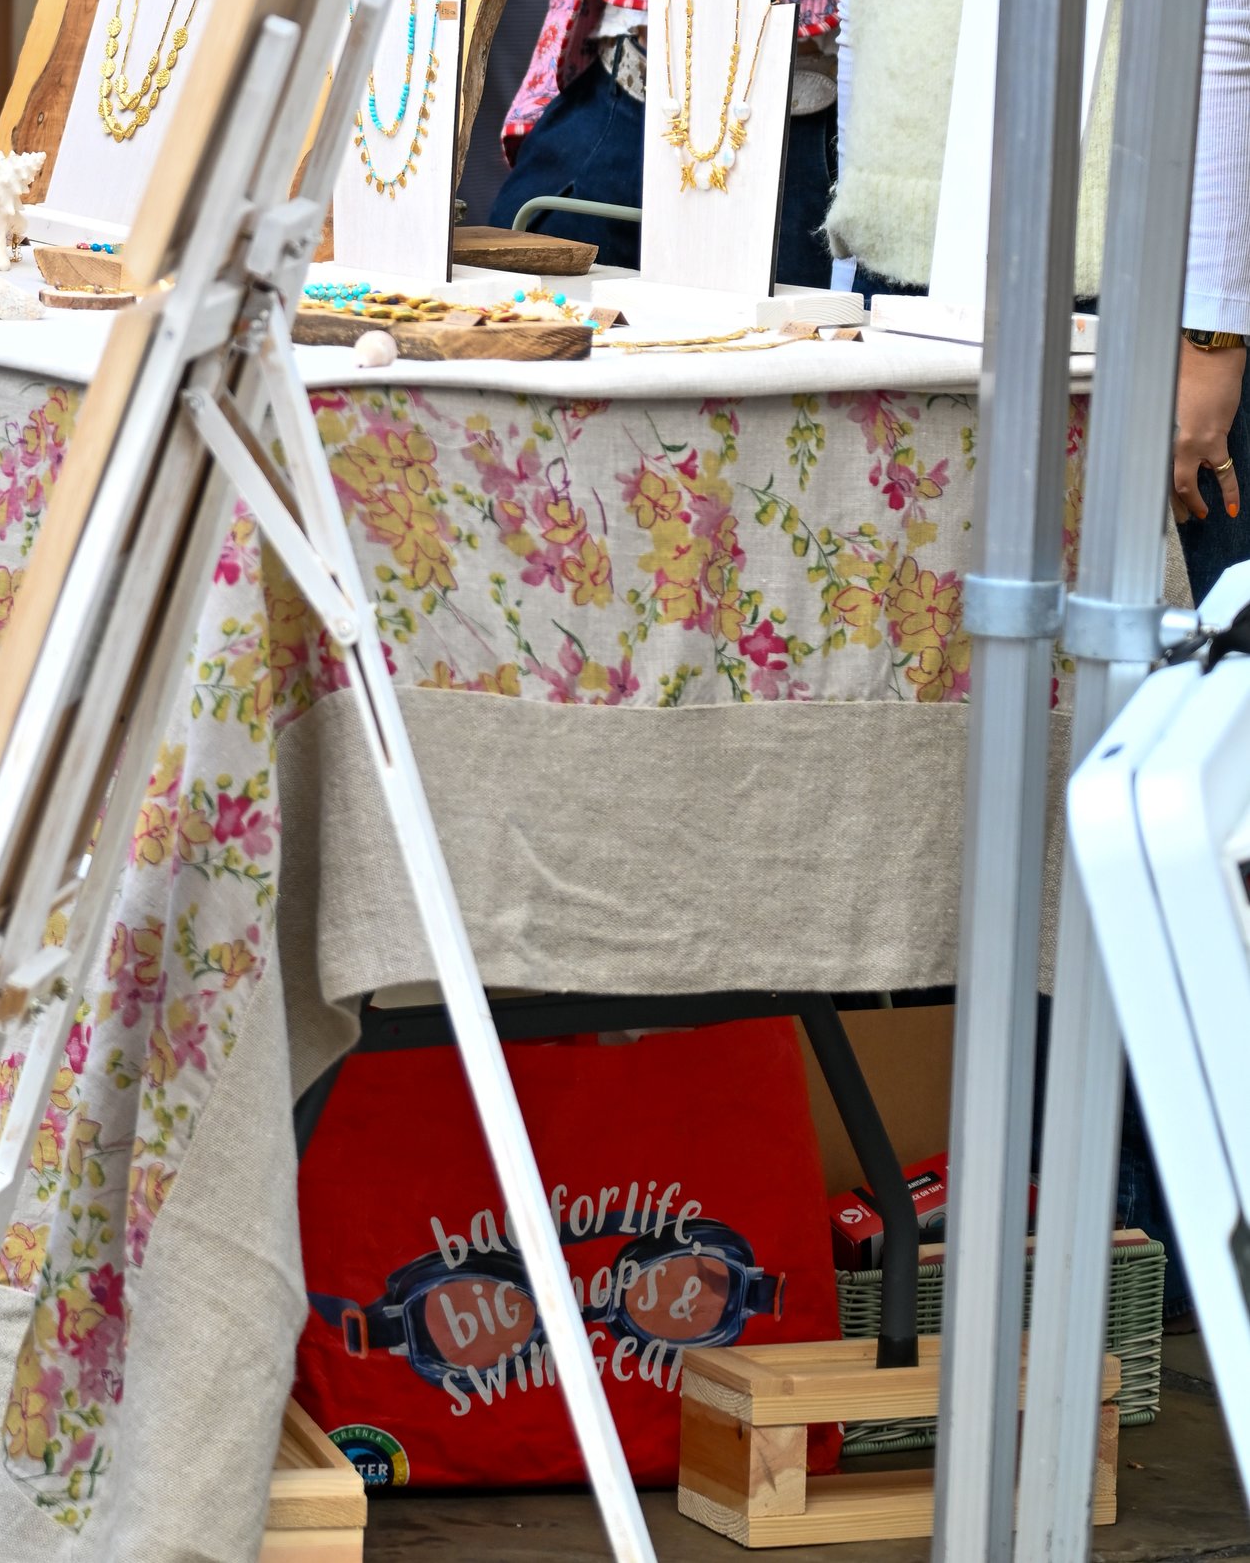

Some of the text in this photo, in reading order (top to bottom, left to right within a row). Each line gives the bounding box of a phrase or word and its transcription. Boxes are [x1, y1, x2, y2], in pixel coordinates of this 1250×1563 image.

[928, 1183, 945, 1194] TAPE
[550, 1184, 619, 1237] for
[669, 1276, 702, 1323] &
[333, 1428, 383, 1443] GREENER
